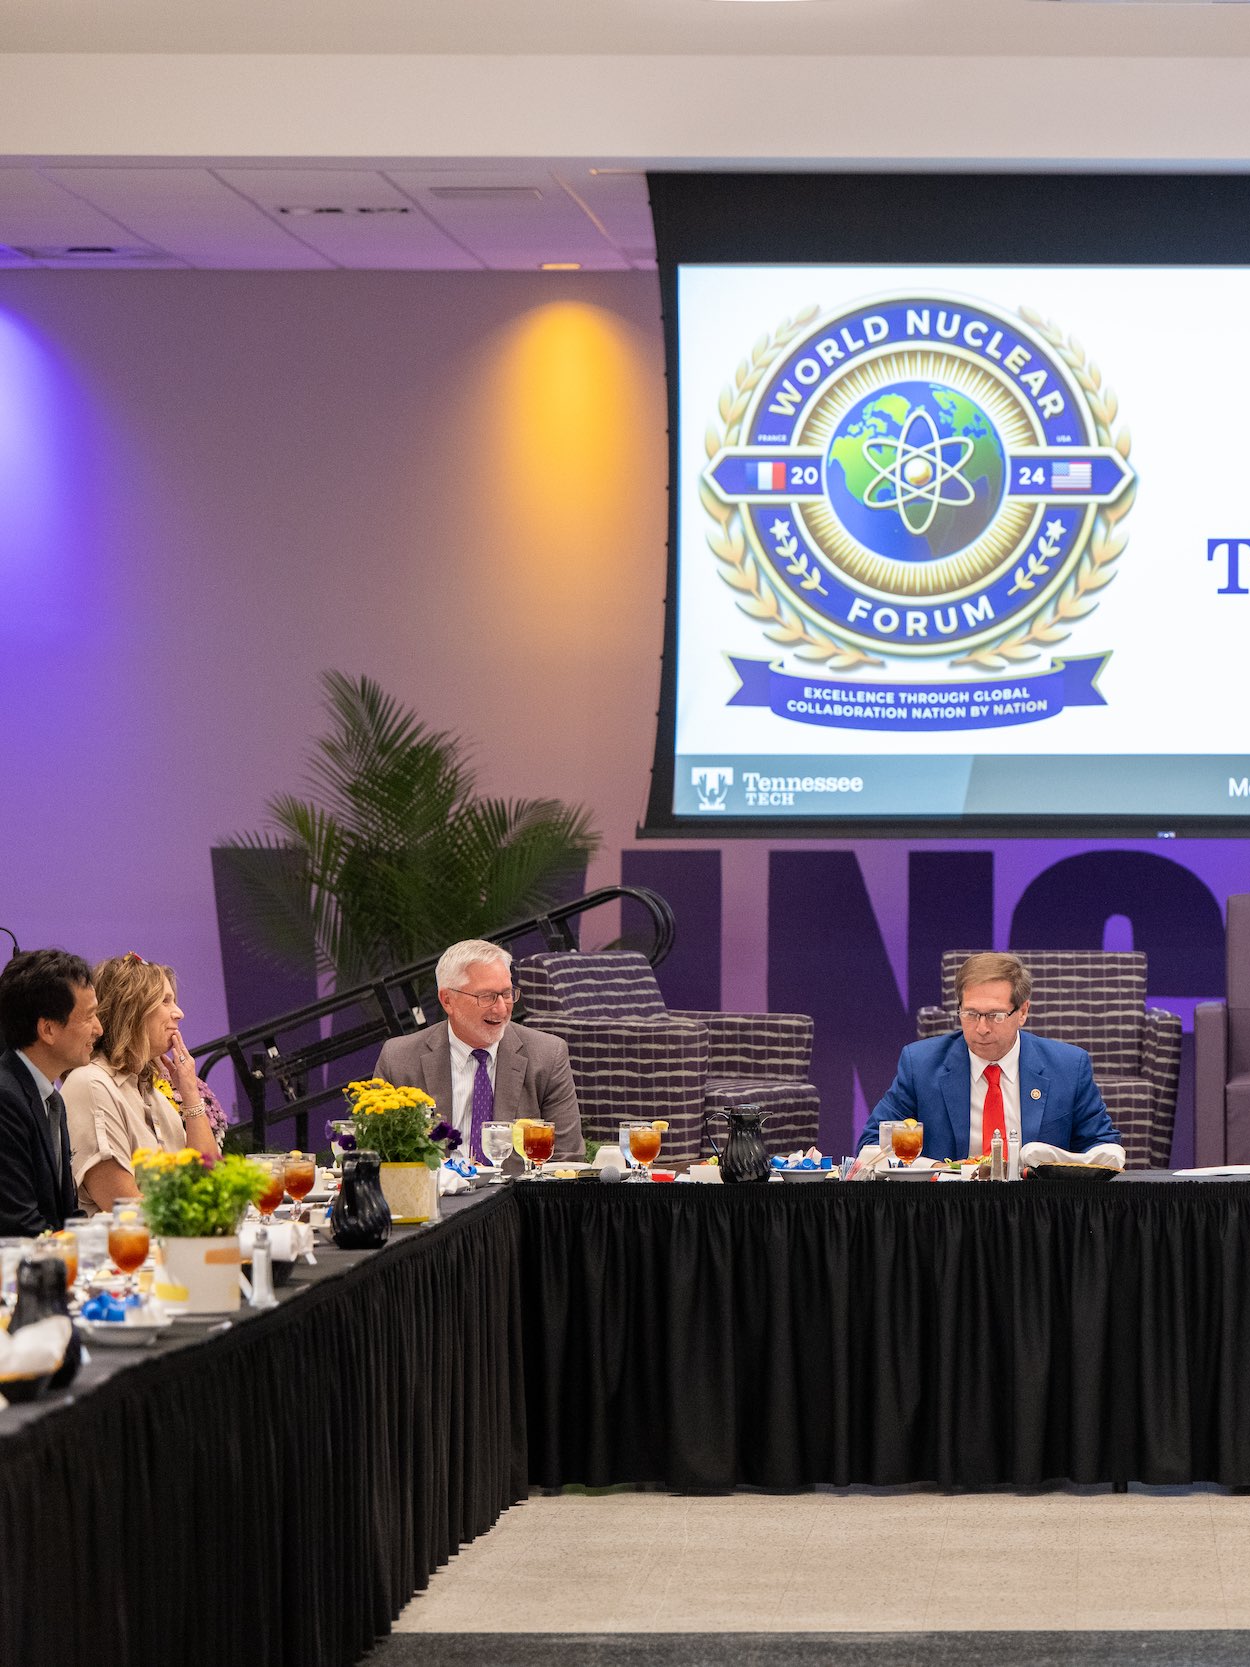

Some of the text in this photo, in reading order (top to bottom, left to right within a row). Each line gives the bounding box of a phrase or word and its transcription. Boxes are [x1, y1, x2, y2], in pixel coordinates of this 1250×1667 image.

[768, 309, 1065, 419] WORLD NUCLEAR
[790, 466, 1046, 486] 20 24
[846, 594, 995, 637] FORUM
[803, 686, 1030, 705] EXCELLENCE THROUGH GLOBAL
[786, 699, 1048, 720] COLLABORATION NATION BY NATION
[742, 772, 864, 793] Tennessee
[745, 792, 795, 806] TECH
